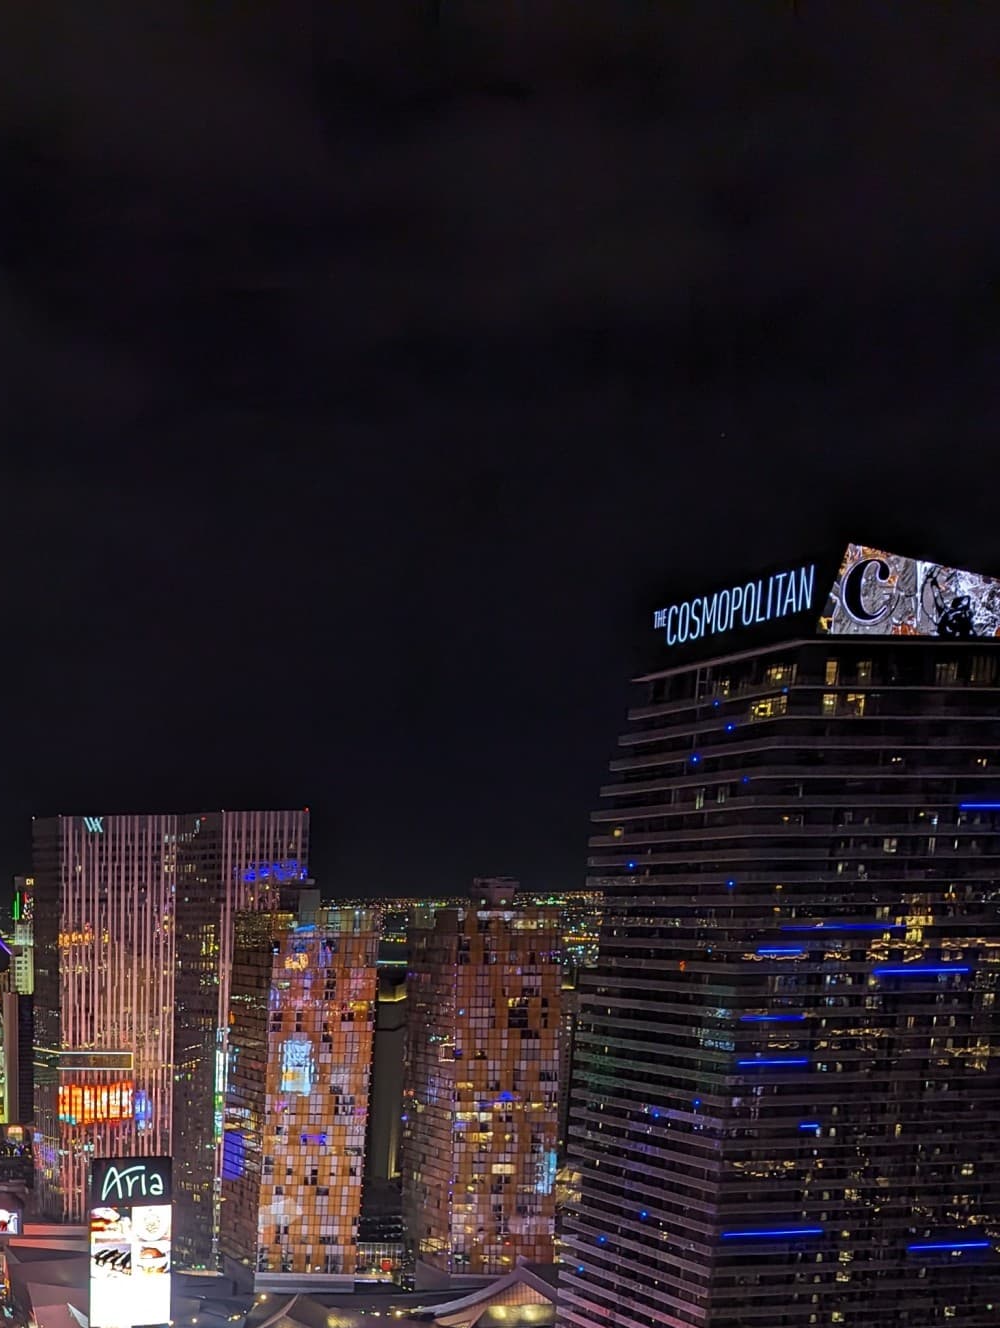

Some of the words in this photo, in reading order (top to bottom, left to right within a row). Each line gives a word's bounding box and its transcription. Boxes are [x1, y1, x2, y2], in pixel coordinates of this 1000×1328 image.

[653, 607, 667, 630] THE
[666, 564, 815, 646] COSMOPOLITAN
[101, 1165, 164, 1201] Aria
